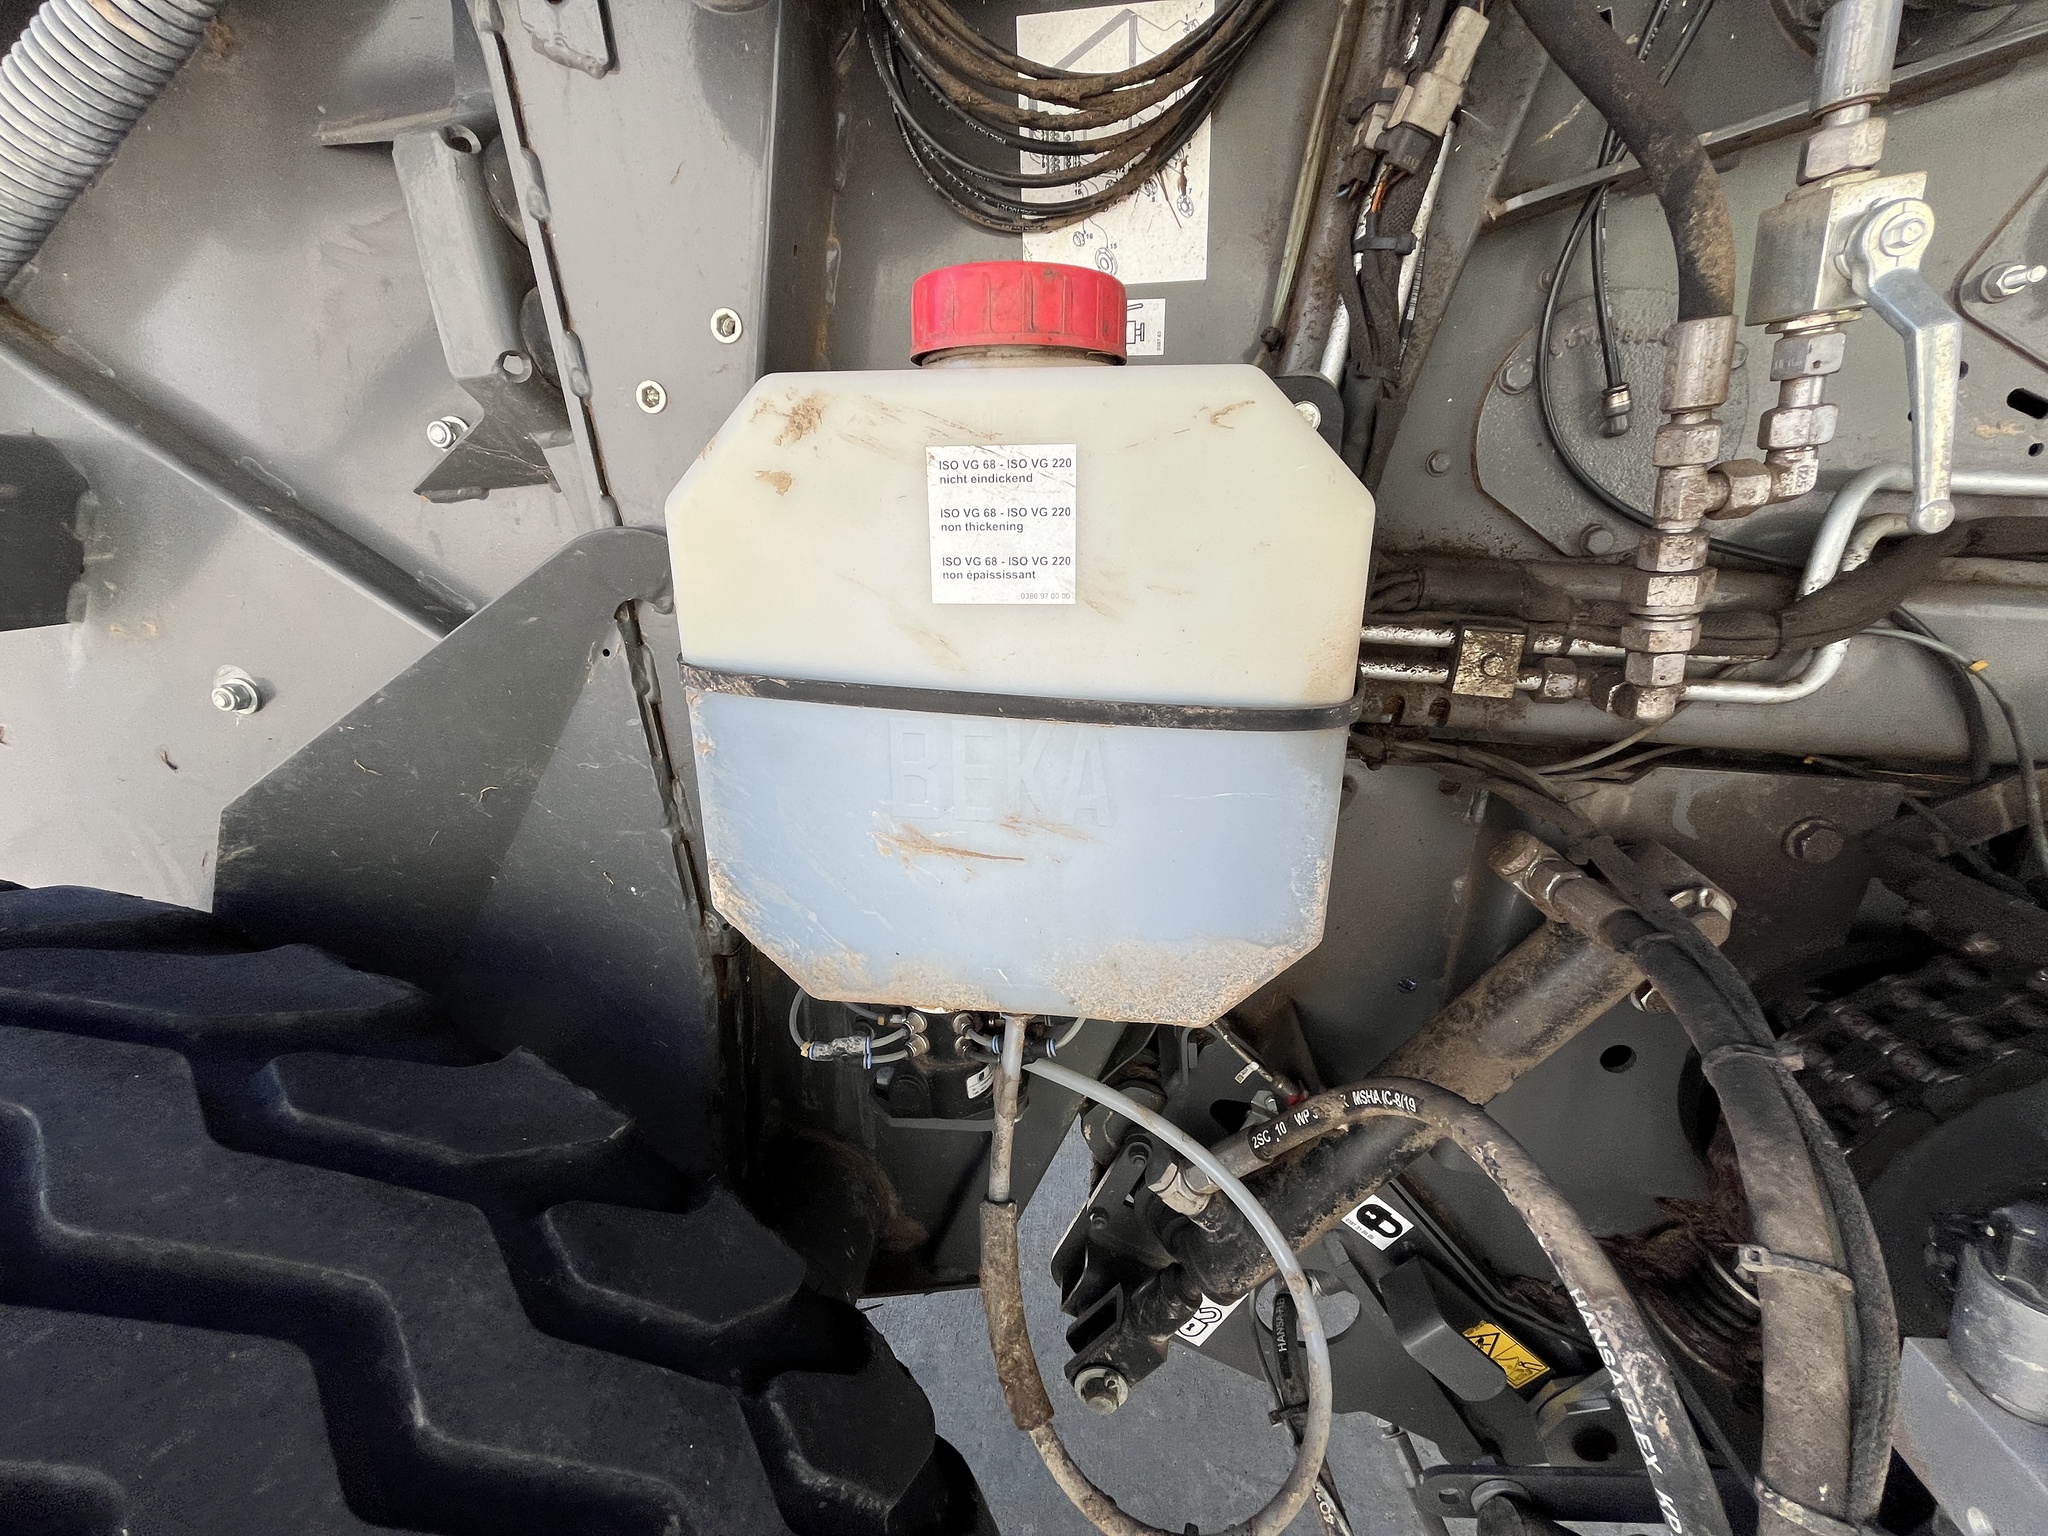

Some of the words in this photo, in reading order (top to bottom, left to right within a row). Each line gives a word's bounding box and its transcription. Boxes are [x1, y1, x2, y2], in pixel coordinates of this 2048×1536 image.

[939, 460, 959, 471] ISO
[962, 460, 979, 470] VG
[983, 459, 996, 469] 68
[1007, 459, 1027, 469] ISO
[1031, 458, 1048, 468] VG
[1052, 458, 1072, 468] 220
[939, 474, 967, 484] nicht
[970, 473, 1033, 484] eindickend
[940, 508, 960, 518] ISO
[963, 508, 980, 518] VG
[983, 508, 997, 517] 68
[1007, 507, 1027, 517] ISO
[1031, 507, 1048, 517] VG
[1051, 507, 1071, 517] 220
[941, 522, 962, 532] non
[965, 521, 1024, 533] thickening
[942, 557, 961, 566] ISO
[965, 557, 981, 566] VG
[985, 556, 998, 566] 68
[1008, 556, 1028, 566] ISO
[1032, 556, 1048, 565] VG
[1052, 556, 1071, 565] 220
[942, 570, 963, 579] non
[966, 570, 1036, 581] épaississant
[888, 717, 1113, 828] BEKA
[1251, 1129, 1272, 1150] 2SC
[1294, 1108, 1311, 1127] WP
[1352, 1089, 1381, 1106] MSHA
[1569, 1288, 1664, 1475] HANSA-FLEX
[1654, 1487, 1683, 1536] KP
